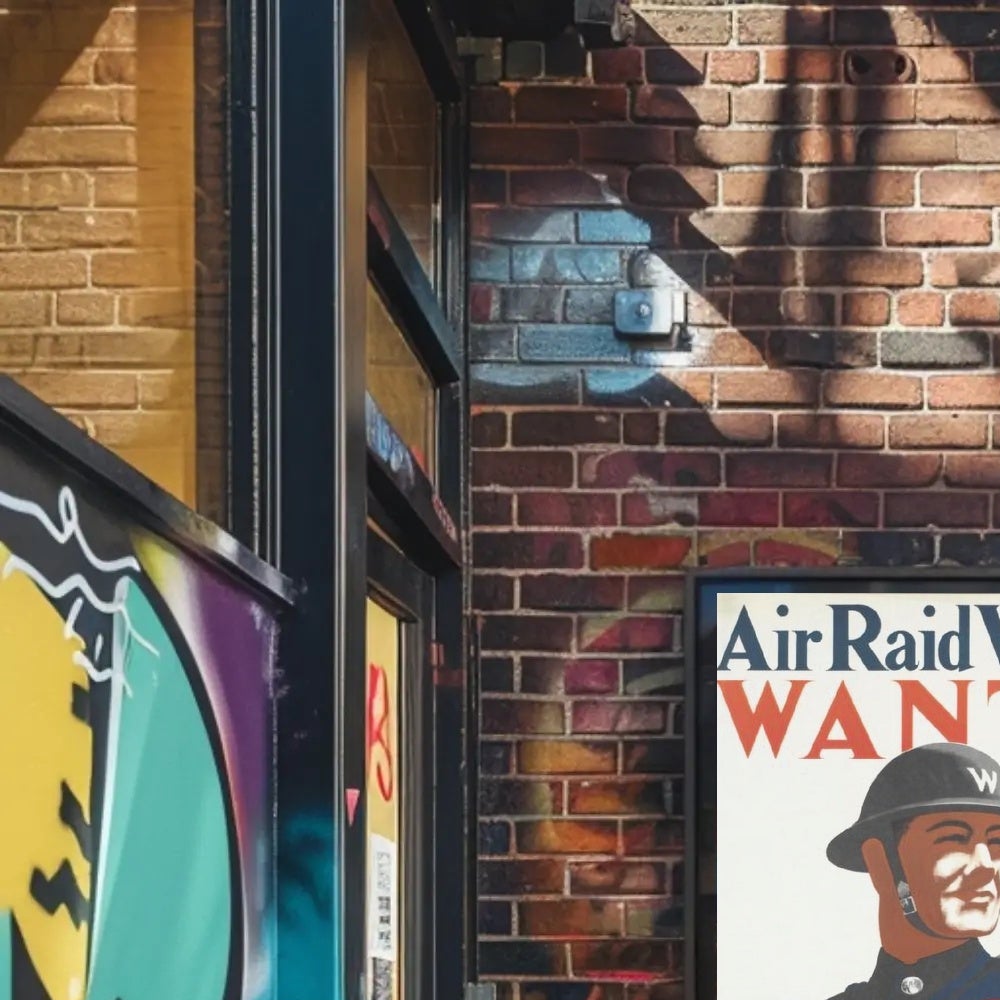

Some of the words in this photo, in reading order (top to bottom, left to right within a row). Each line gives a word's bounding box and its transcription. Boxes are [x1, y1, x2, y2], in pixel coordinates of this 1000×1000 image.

[718, 604, 822, 672] Air
[826, 604, 974, 672] Raid
[966, 767, 998, 794] W
